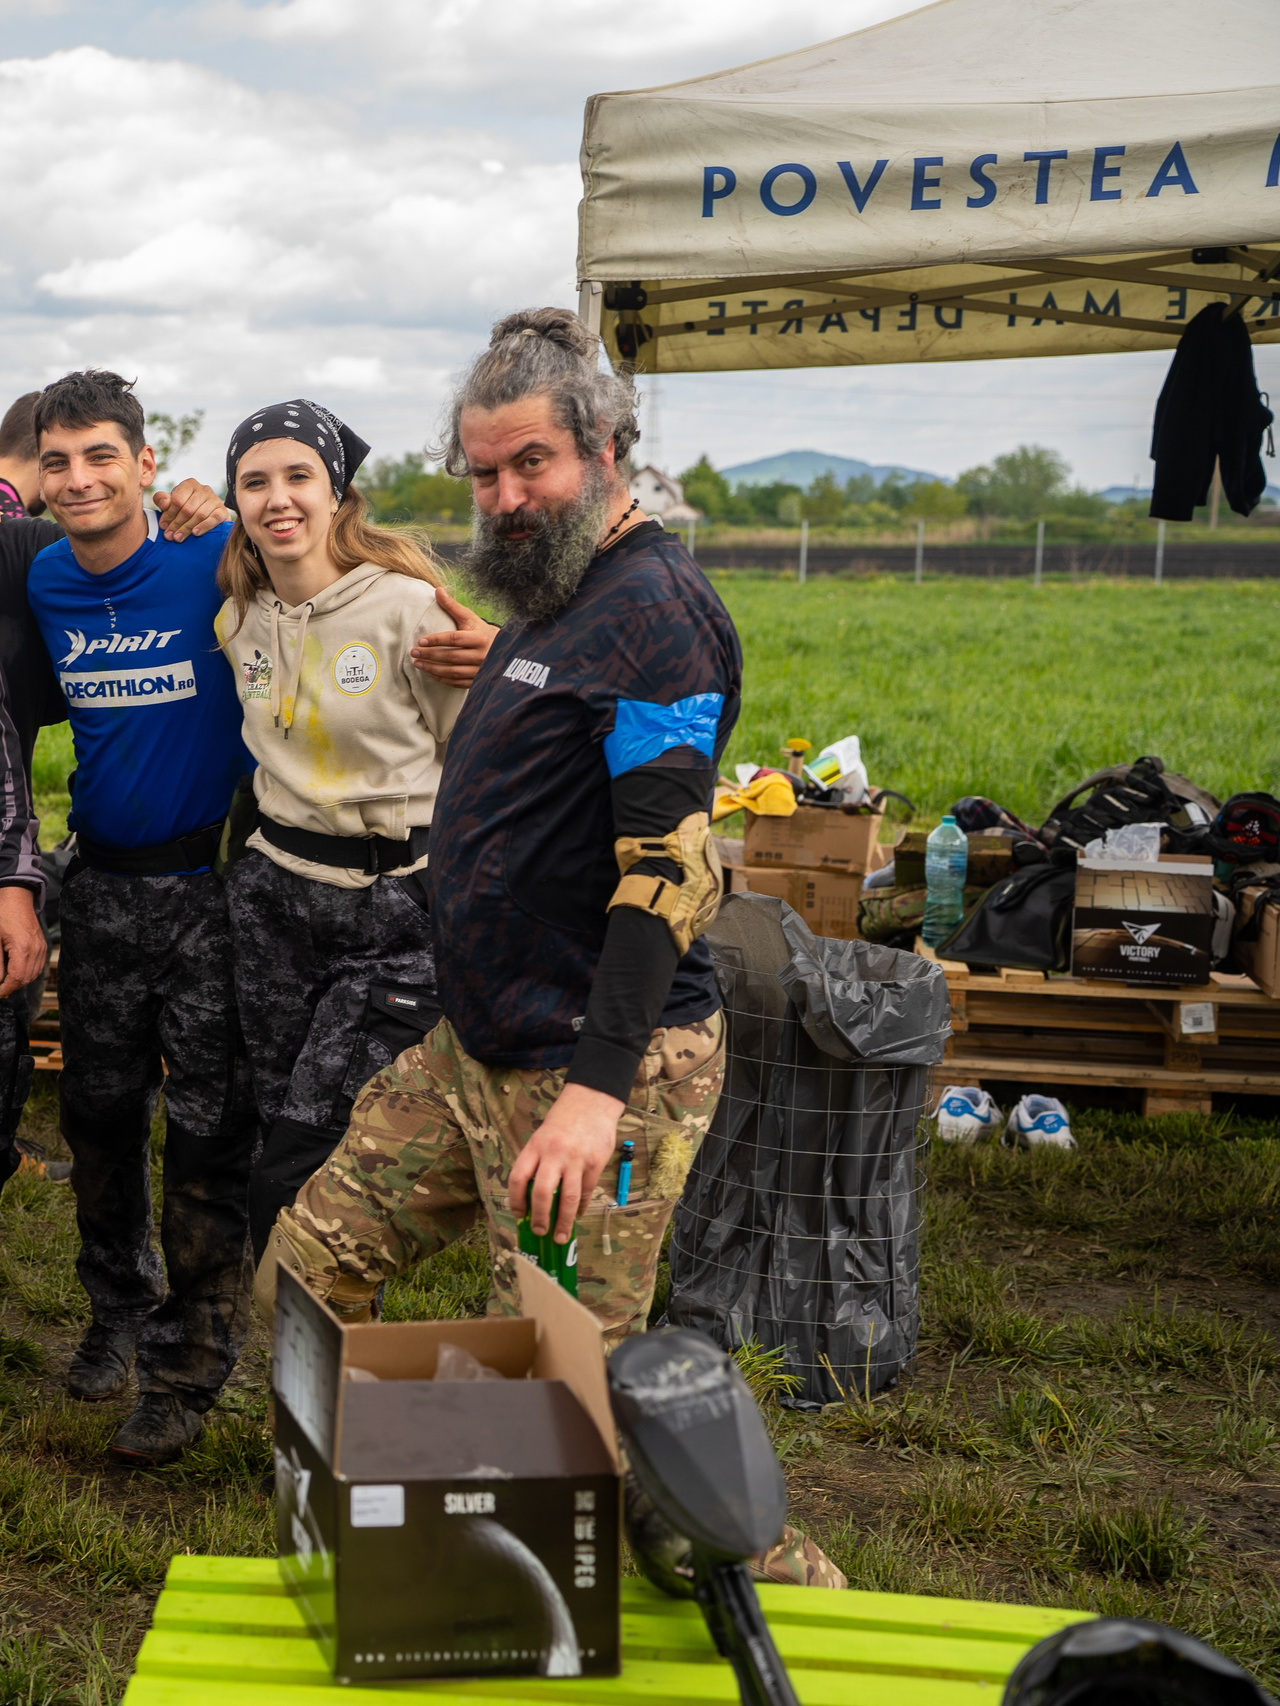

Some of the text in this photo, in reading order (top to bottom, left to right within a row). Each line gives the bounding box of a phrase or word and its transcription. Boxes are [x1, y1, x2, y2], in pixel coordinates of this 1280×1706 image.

[701, 140, 1200, 218] POVESTEA
[341, 675, 370, 685] BODEGA
[1120, 944, 1161, 958] VICTORY
[444, 1492, 496, 1515] SILVER
